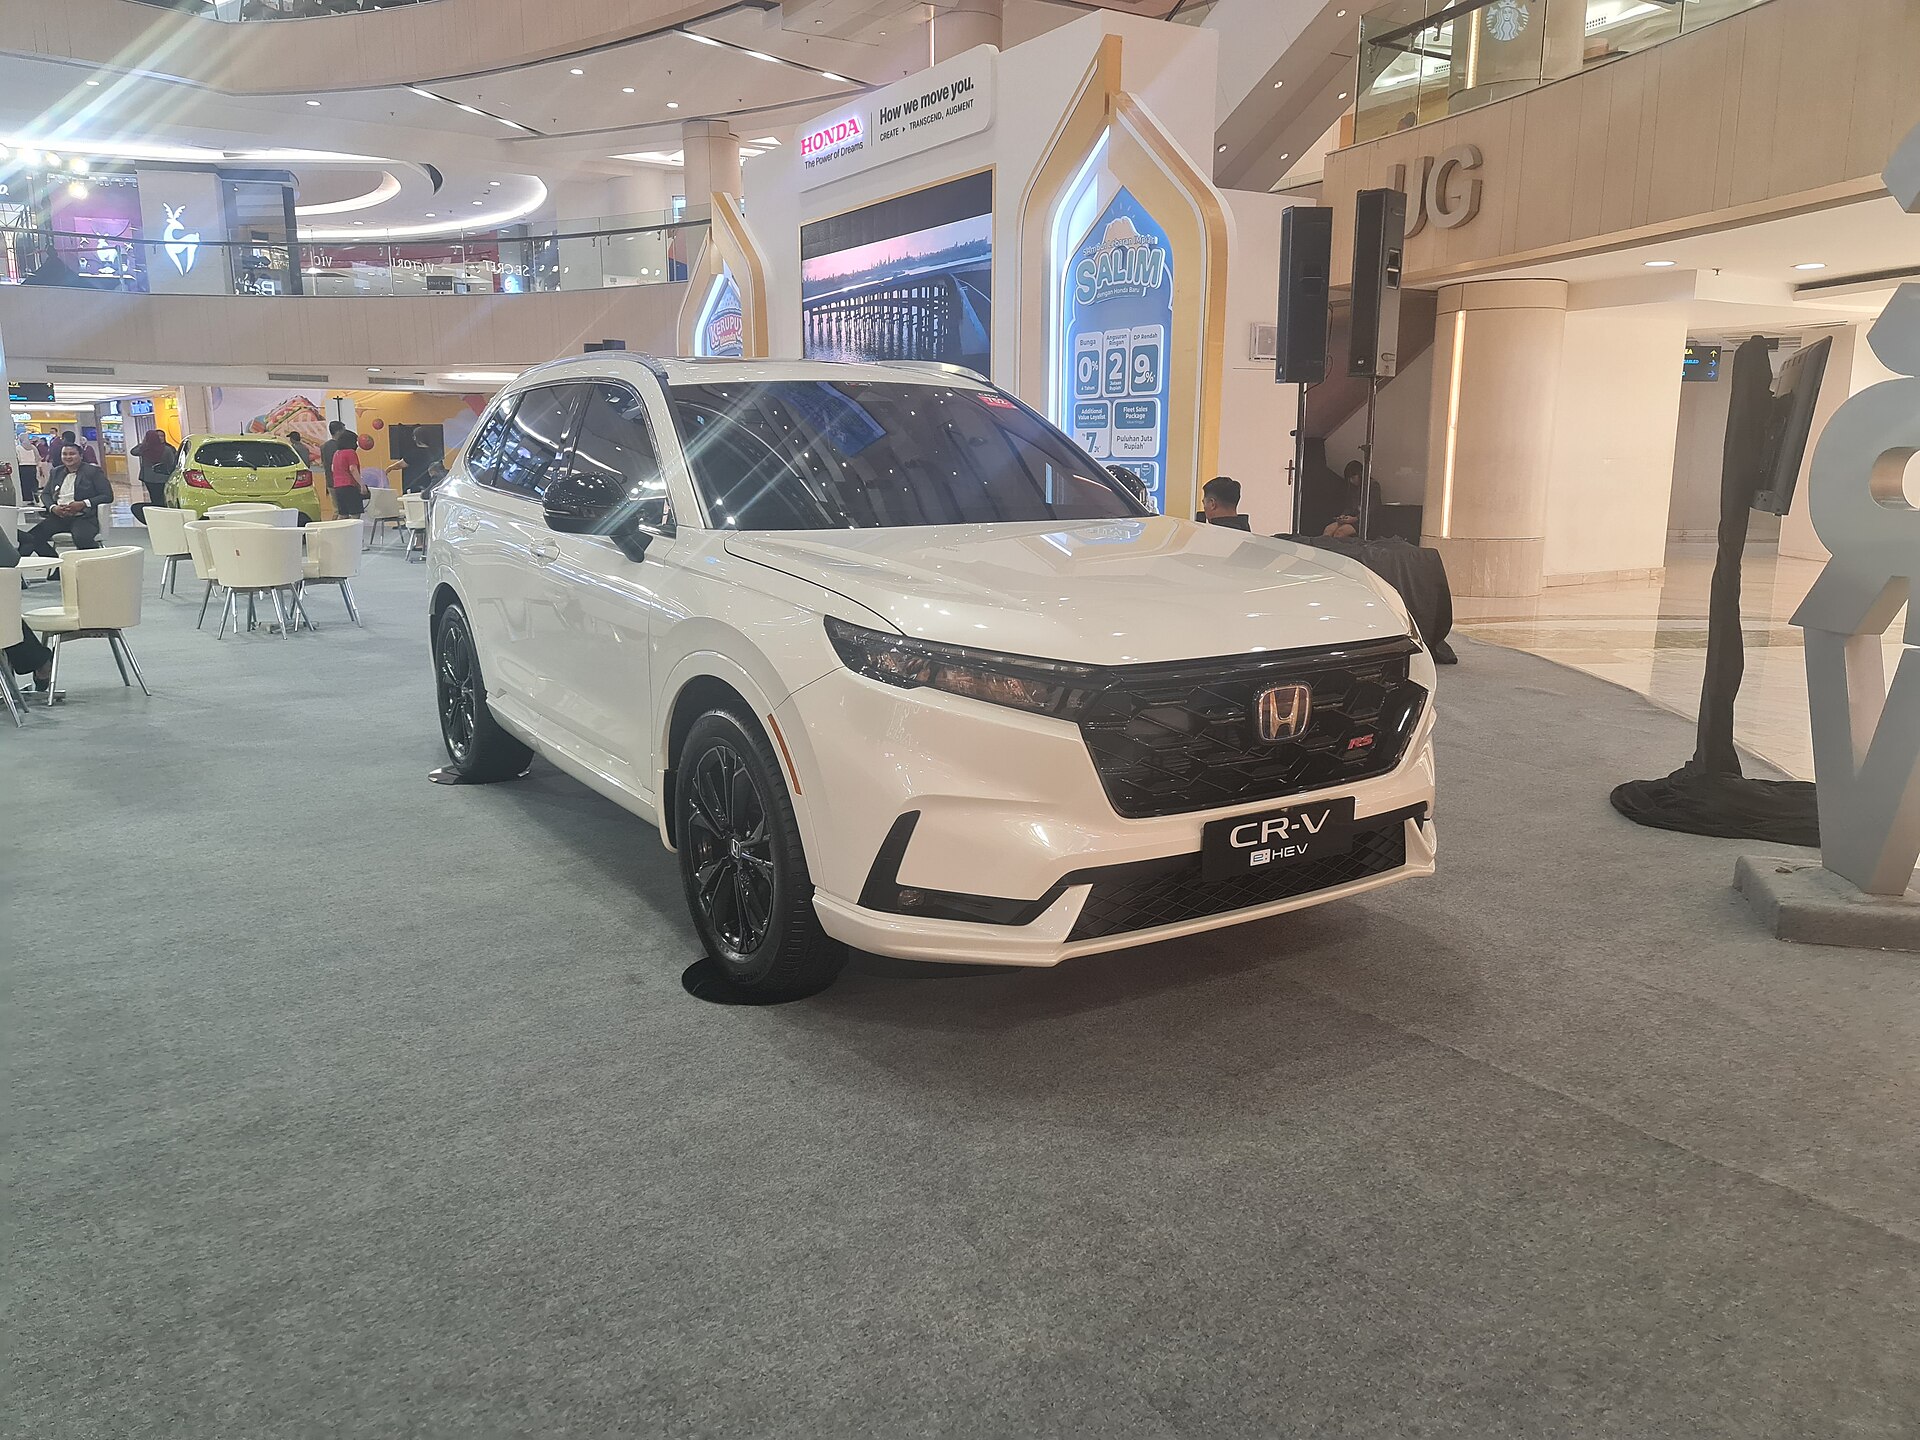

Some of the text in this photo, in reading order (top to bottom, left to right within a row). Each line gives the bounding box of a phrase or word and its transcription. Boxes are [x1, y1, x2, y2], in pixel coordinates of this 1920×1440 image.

[879, 76, 975, 125] How we move you.
[879, 99, 974, 142] CREATE TRANSCEND, AUGMENT
[800, 118, 861, 156] HONDA
[805, 141, 864, 170] The Power of Dreams
[1076, 246, 1165, 305] SALIM
[1114, 287, 1128, 295] Honda
[1141, 332, 1158, 340] Rendah
[1109, 352, 1123, 380] 2
[1086, 431, 1097, 453] 7
[1347, 734, 1374, 749] RS
[1229, 809, 1331, 849] CR-V
